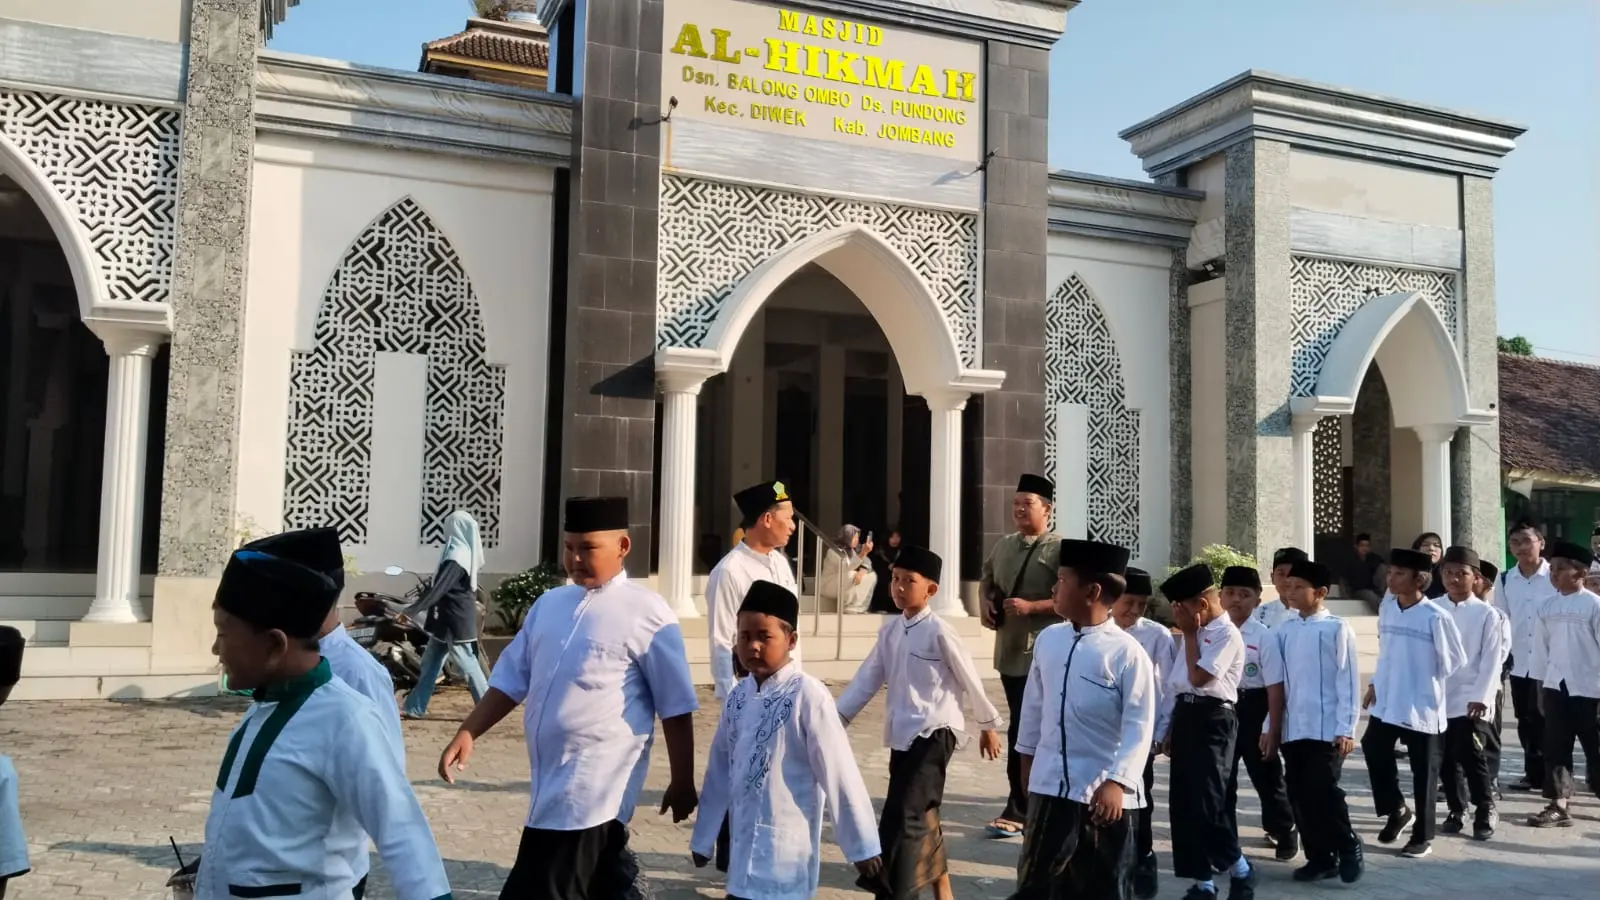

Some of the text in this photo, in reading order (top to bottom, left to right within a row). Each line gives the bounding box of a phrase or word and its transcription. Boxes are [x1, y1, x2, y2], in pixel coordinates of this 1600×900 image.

[778, 9, 883, 46] MASJID
[670, 23, 976, 102] AL-HIKMAH
[704, 96, 955, 148] Kec. DIWEK Kab. JOMBANG
[728, 73, 798, 99] BALONG
[804, 86, 852, 108] OMBO
[862, 95, 886, 113] Ds.
[892, 100, 967, 125] PUNDONG
